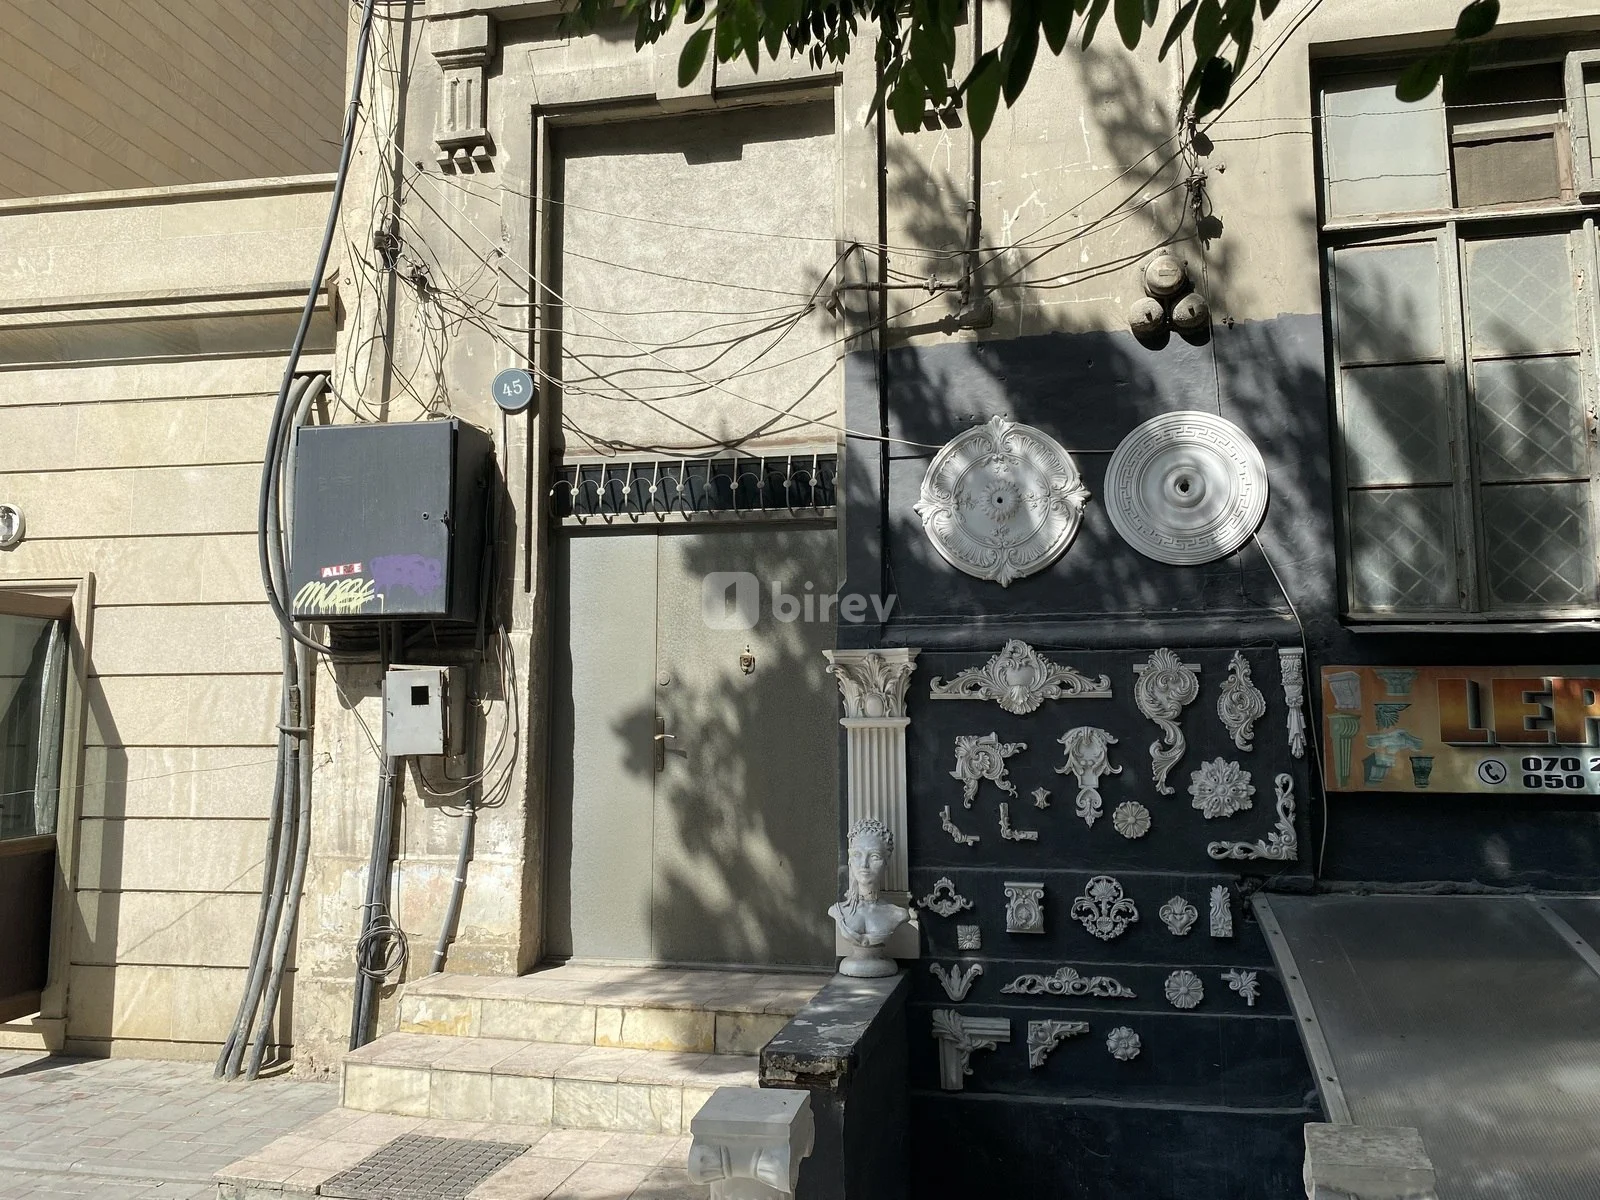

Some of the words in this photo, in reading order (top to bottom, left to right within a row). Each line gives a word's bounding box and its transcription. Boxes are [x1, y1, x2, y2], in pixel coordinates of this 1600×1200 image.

[502, 379, 523, 397] 45
[322, 562, 362, 578] ALIE
[1521, 757, 1581, 772] 070
[1522, 774, 1585, 789] 050
